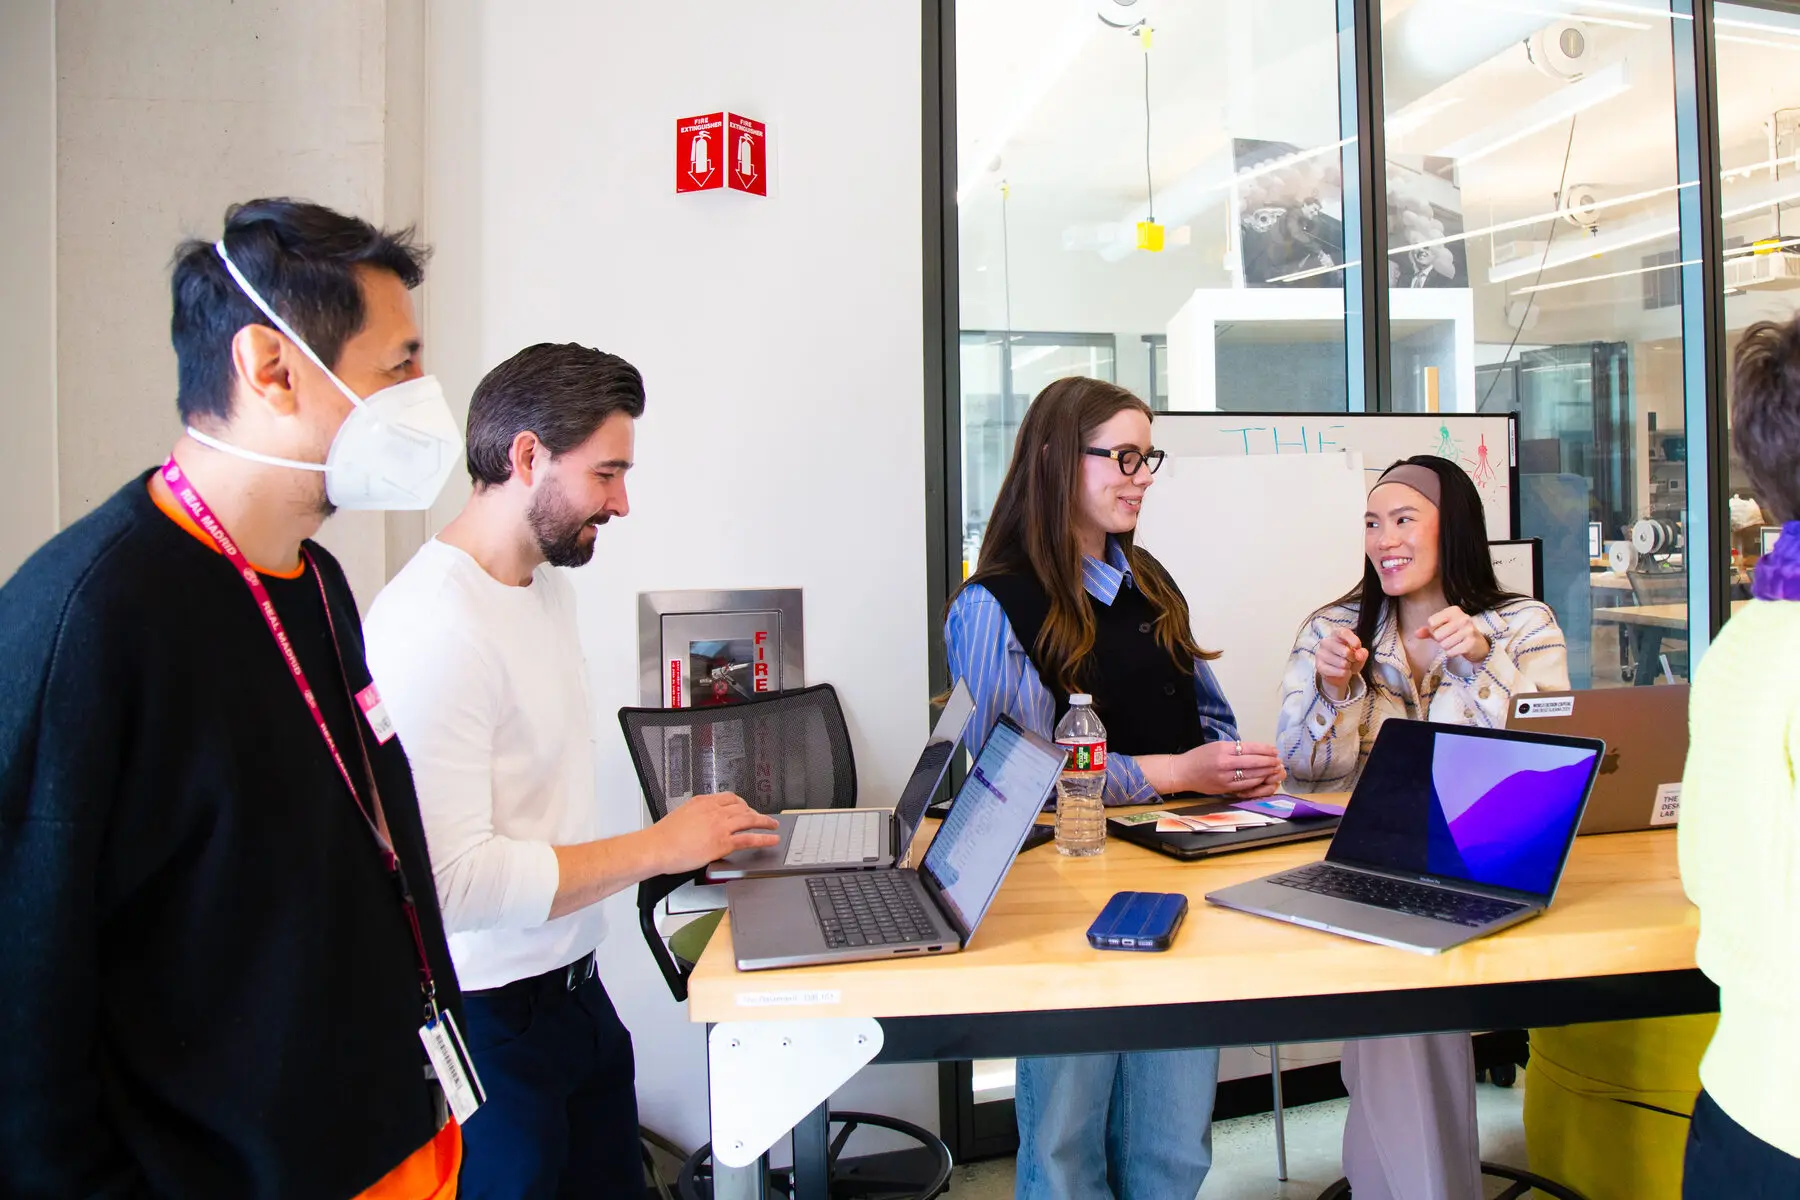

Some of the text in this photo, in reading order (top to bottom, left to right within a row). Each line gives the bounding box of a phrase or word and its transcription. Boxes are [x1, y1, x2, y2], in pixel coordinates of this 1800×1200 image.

[680, 121, 722, 133] EXTINGUISHER
[694, 117, 709, 125] FIRE
[729, 121, 763, 137] EXTINGUISHER
[740, 119, 752, 128] FIRE
[179, 488, 237, 556] REAL MADRID
[262, 600, 301, 676] REAL MADRID
[755, 631, 768, 692] FIRE
